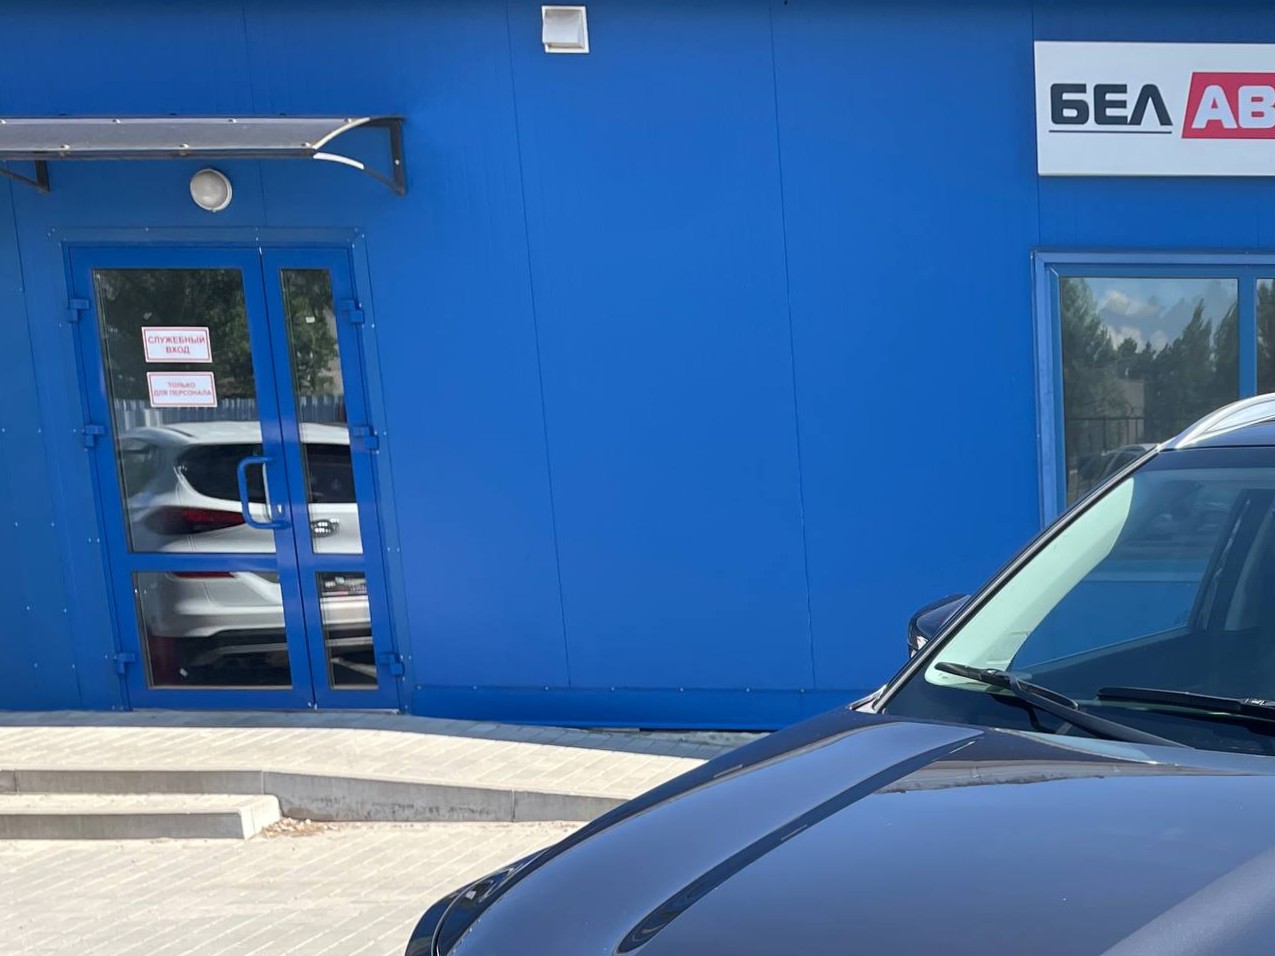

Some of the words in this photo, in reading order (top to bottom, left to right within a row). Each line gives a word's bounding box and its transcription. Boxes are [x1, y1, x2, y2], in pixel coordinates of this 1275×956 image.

[1049, 83, 1173, 126] БЕЛ
[148, 335, 206, 345] СЛУЖЕБНЫЙ
[166, 346, 191, 355] ВХОД
